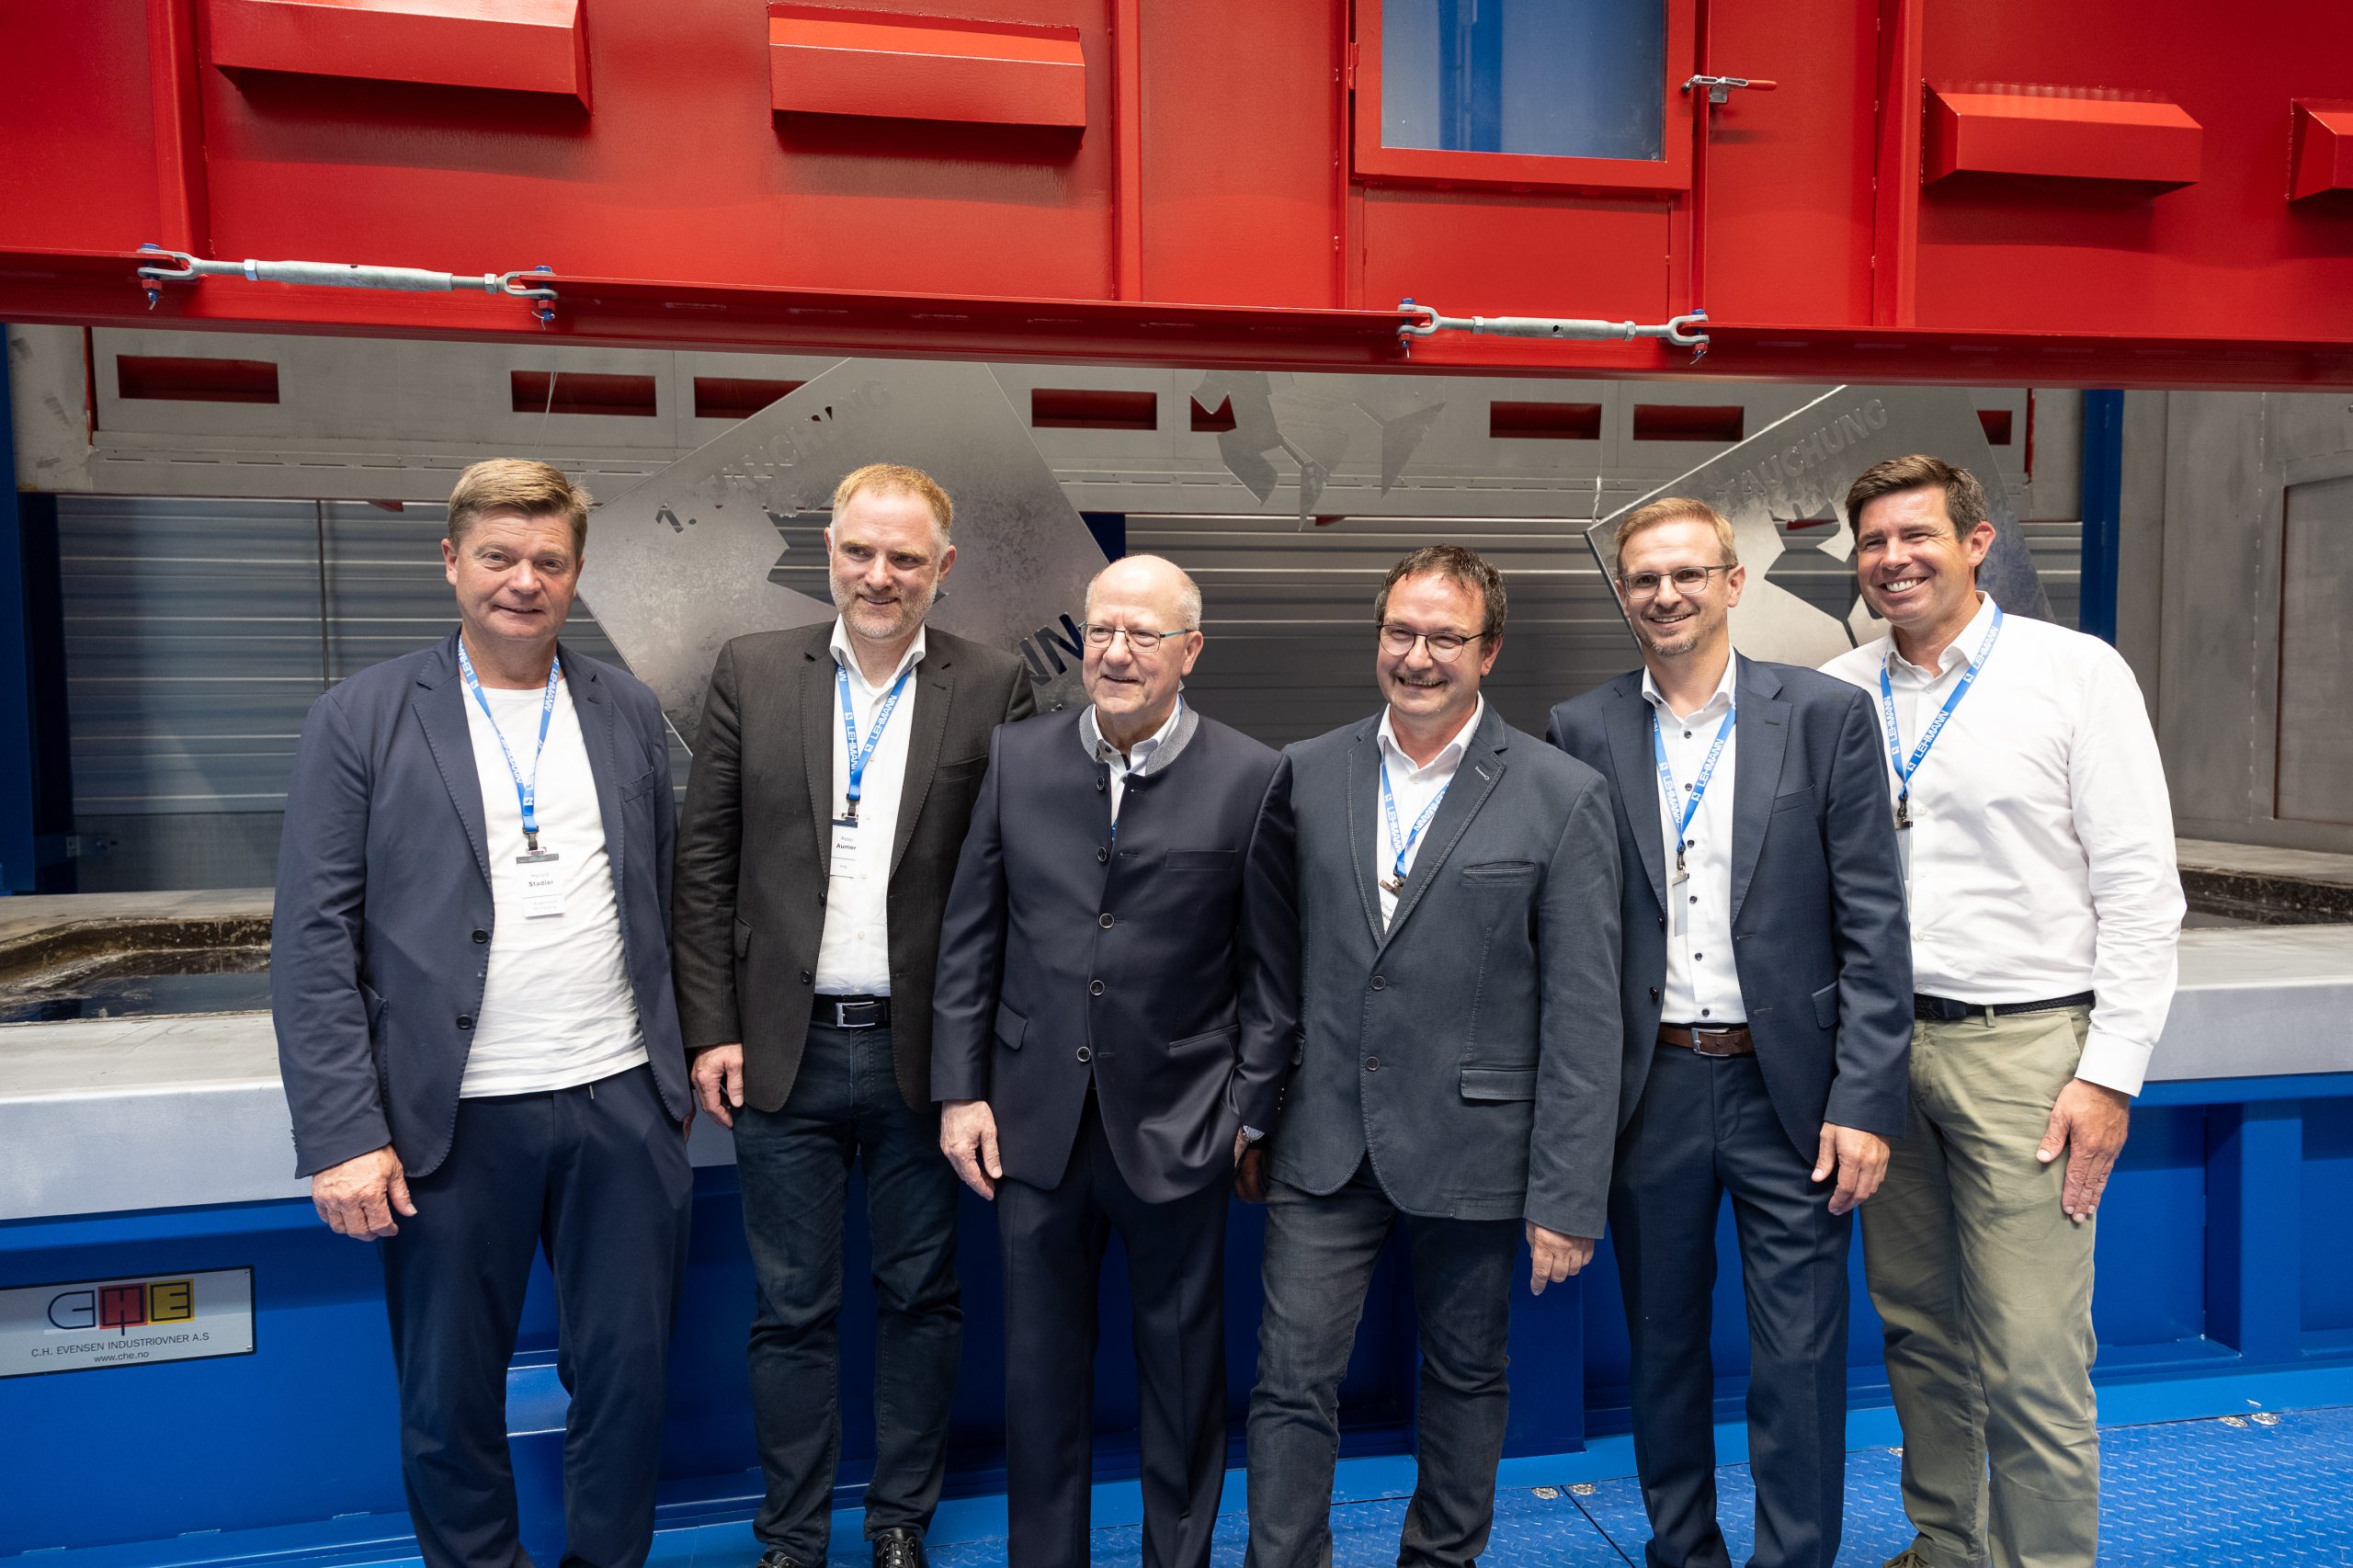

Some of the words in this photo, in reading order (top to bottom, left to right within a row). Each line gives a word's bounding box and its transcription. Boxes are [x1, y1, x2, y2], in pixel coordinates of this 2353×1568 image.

[1972, 625, 1999, 670] LEHMANN
[544, 667, 559, 712] LEHMANN
[870, 695, 898, 740] LEHMANN
[1884, 696, 1899, 742] LEHMANN
[1914, 710, 1949, 758] LEHMANN
[1698, 738, 1725, 788] LEHMANN
[1663, 775, 1681, 824] LEHMANN
[31, 1348, 53, 1358] C.H.
[57, 1343, 105, 1356] EVENSEN
[108, 1335, 189, 1350] INDUSTRIOVNER
[192, 1332, 210, 1342] A.S
[94, 1351, 150, 1363] www.che.no
